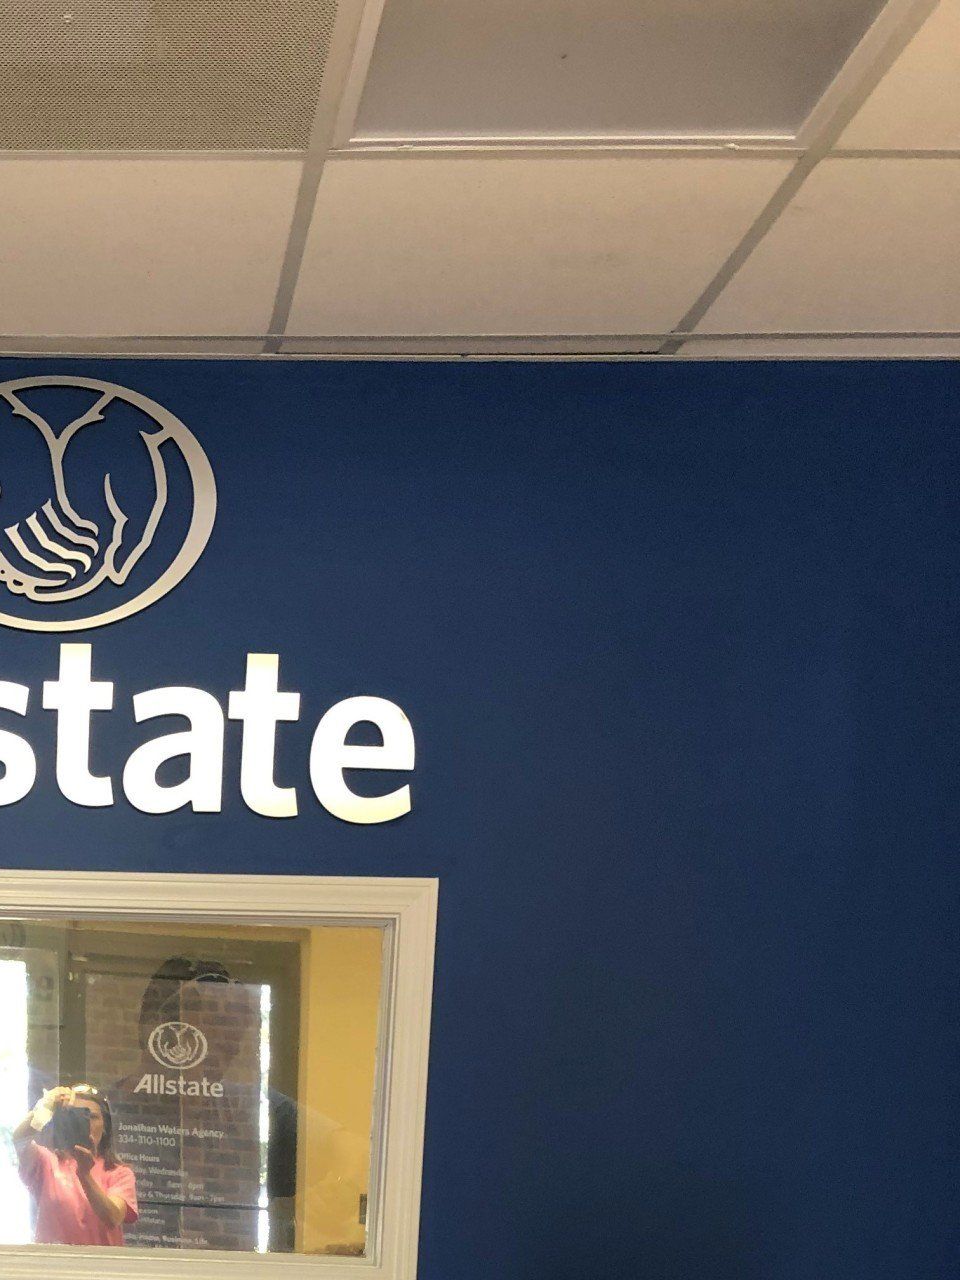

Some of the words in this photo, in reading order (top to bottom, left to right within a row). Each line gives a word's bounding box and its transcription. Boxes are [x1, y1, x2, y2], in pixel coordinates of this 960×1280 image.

[133, 1073, 224, 1098] Allstate
[118, 1122, 157, 1134] Jonathan
[192, 1127, 225, 1139] Agency
